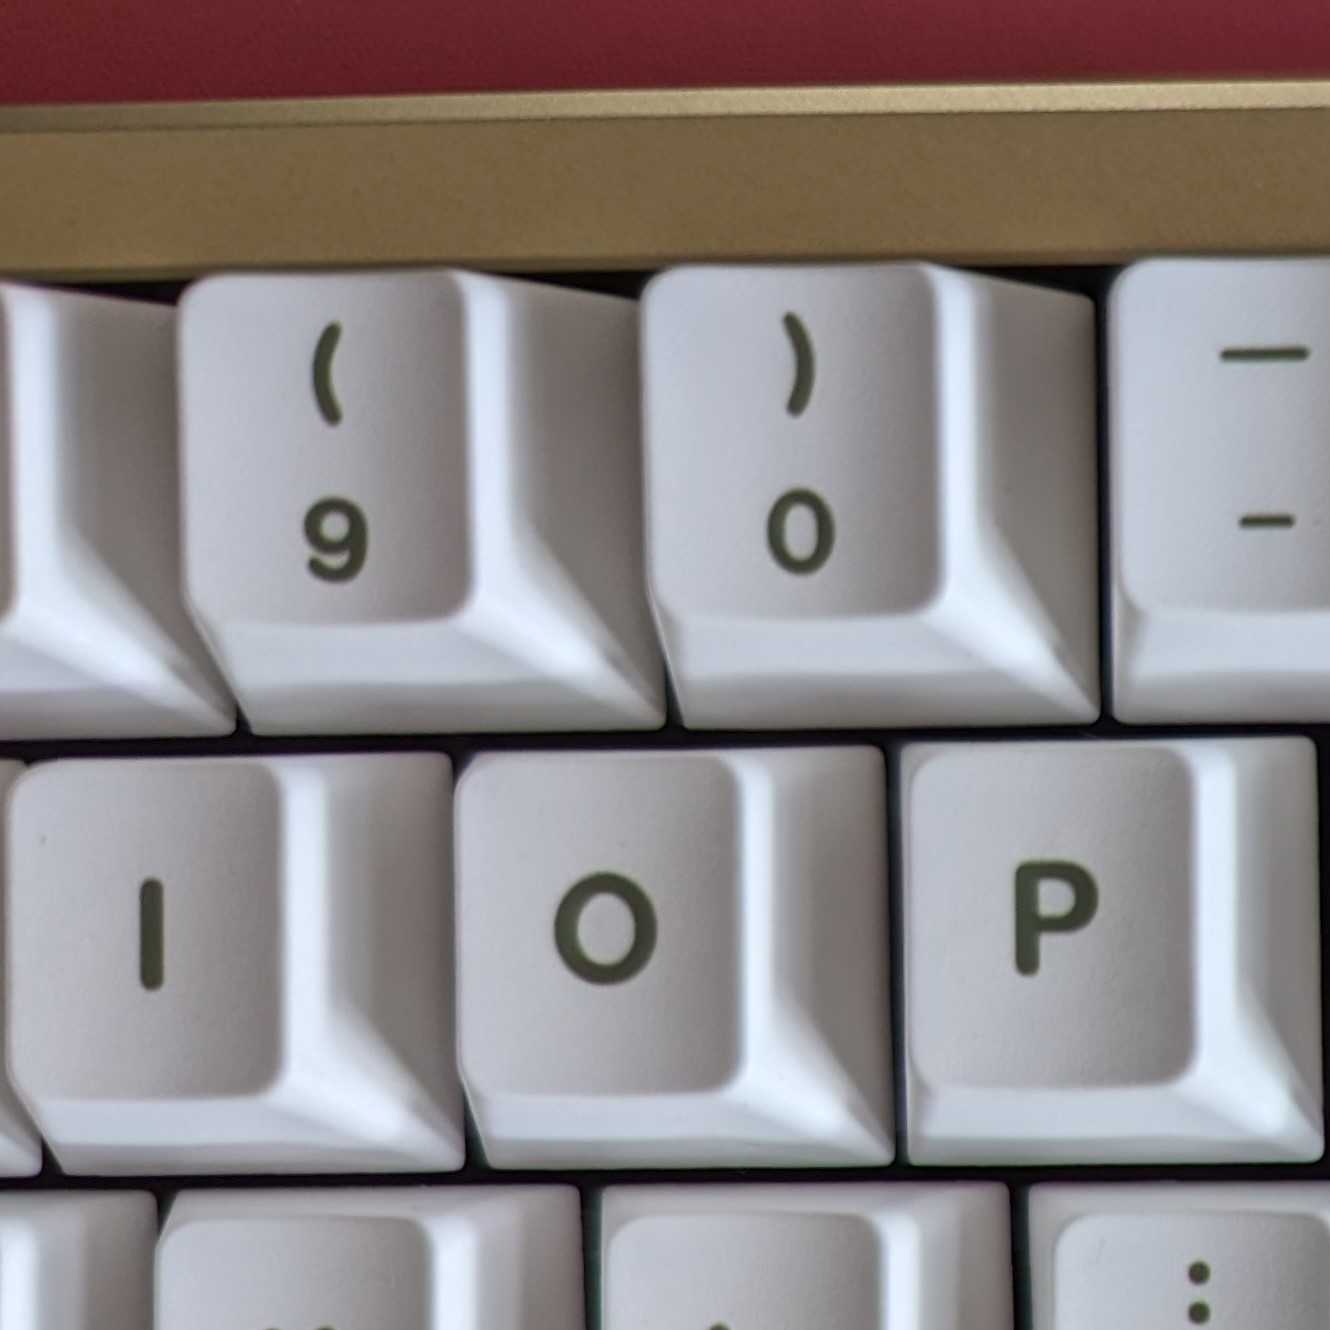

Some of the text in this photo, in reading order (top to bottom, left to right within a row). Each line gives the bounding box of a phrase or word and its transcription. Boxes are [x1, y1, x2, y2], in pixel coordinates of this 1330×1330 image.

[310, 321, 343, 428] (
[781, 311, 816, 418] )
[302, 496, 369, 584] 9
[137, 877, 165, 992] I
[552, 871, 659, 987] O
[1013, 859, 1100, 977] P
[1186, 1260, 1212, 1326] :
